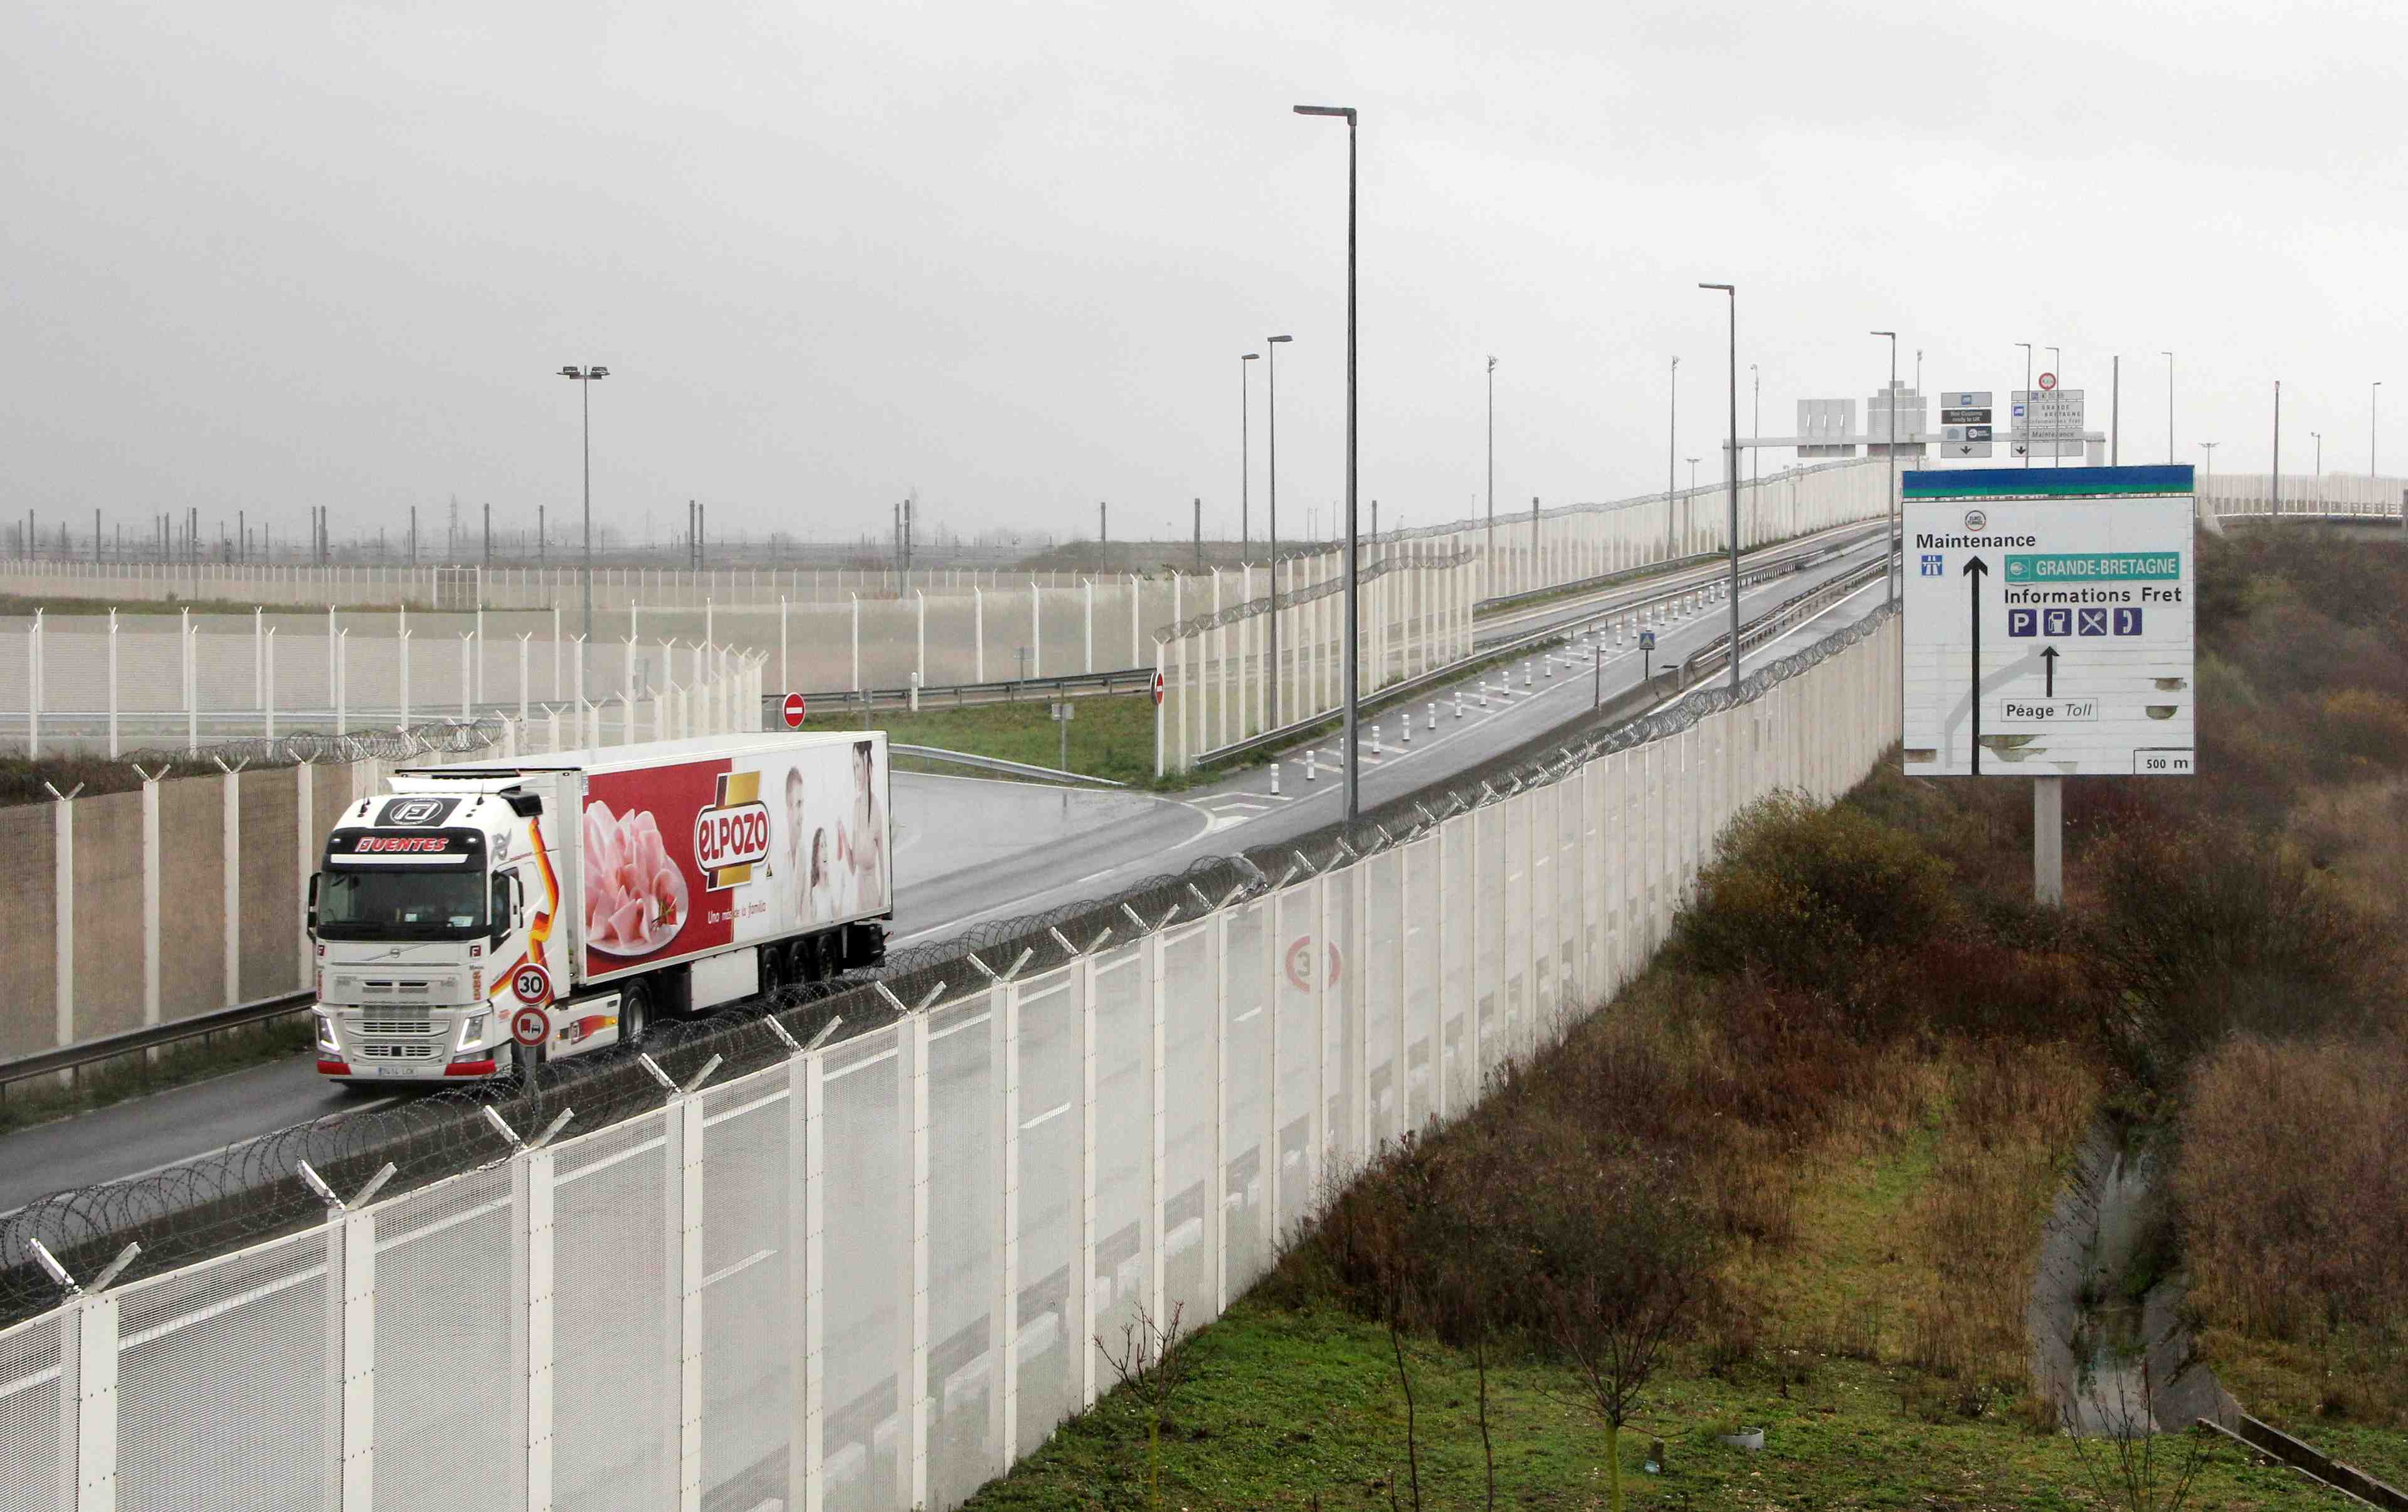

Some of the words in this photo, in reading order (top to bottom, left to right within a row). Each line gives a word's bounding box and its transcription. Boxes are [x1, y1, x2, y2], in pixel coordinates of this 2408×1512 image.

[1916, 534, 2036, 548] Maintenance
[2036, 558, 2177, 575] GRANDE-BRETAGNE
[2005, 588, 2131, 603] Informations
[2142, 587, 2182, 602] Fret
[2014, 613, 2029, 633] P
[2007, 704, 2054, 719] Péage
[2066, 703, 2092, 716] Toll
[2147, 759, 2166, 769] 500
[2173, 759, 2188, 769] m
[355, 836, 449, 852] FUENTES
[519, 976, 543, 993] 30
